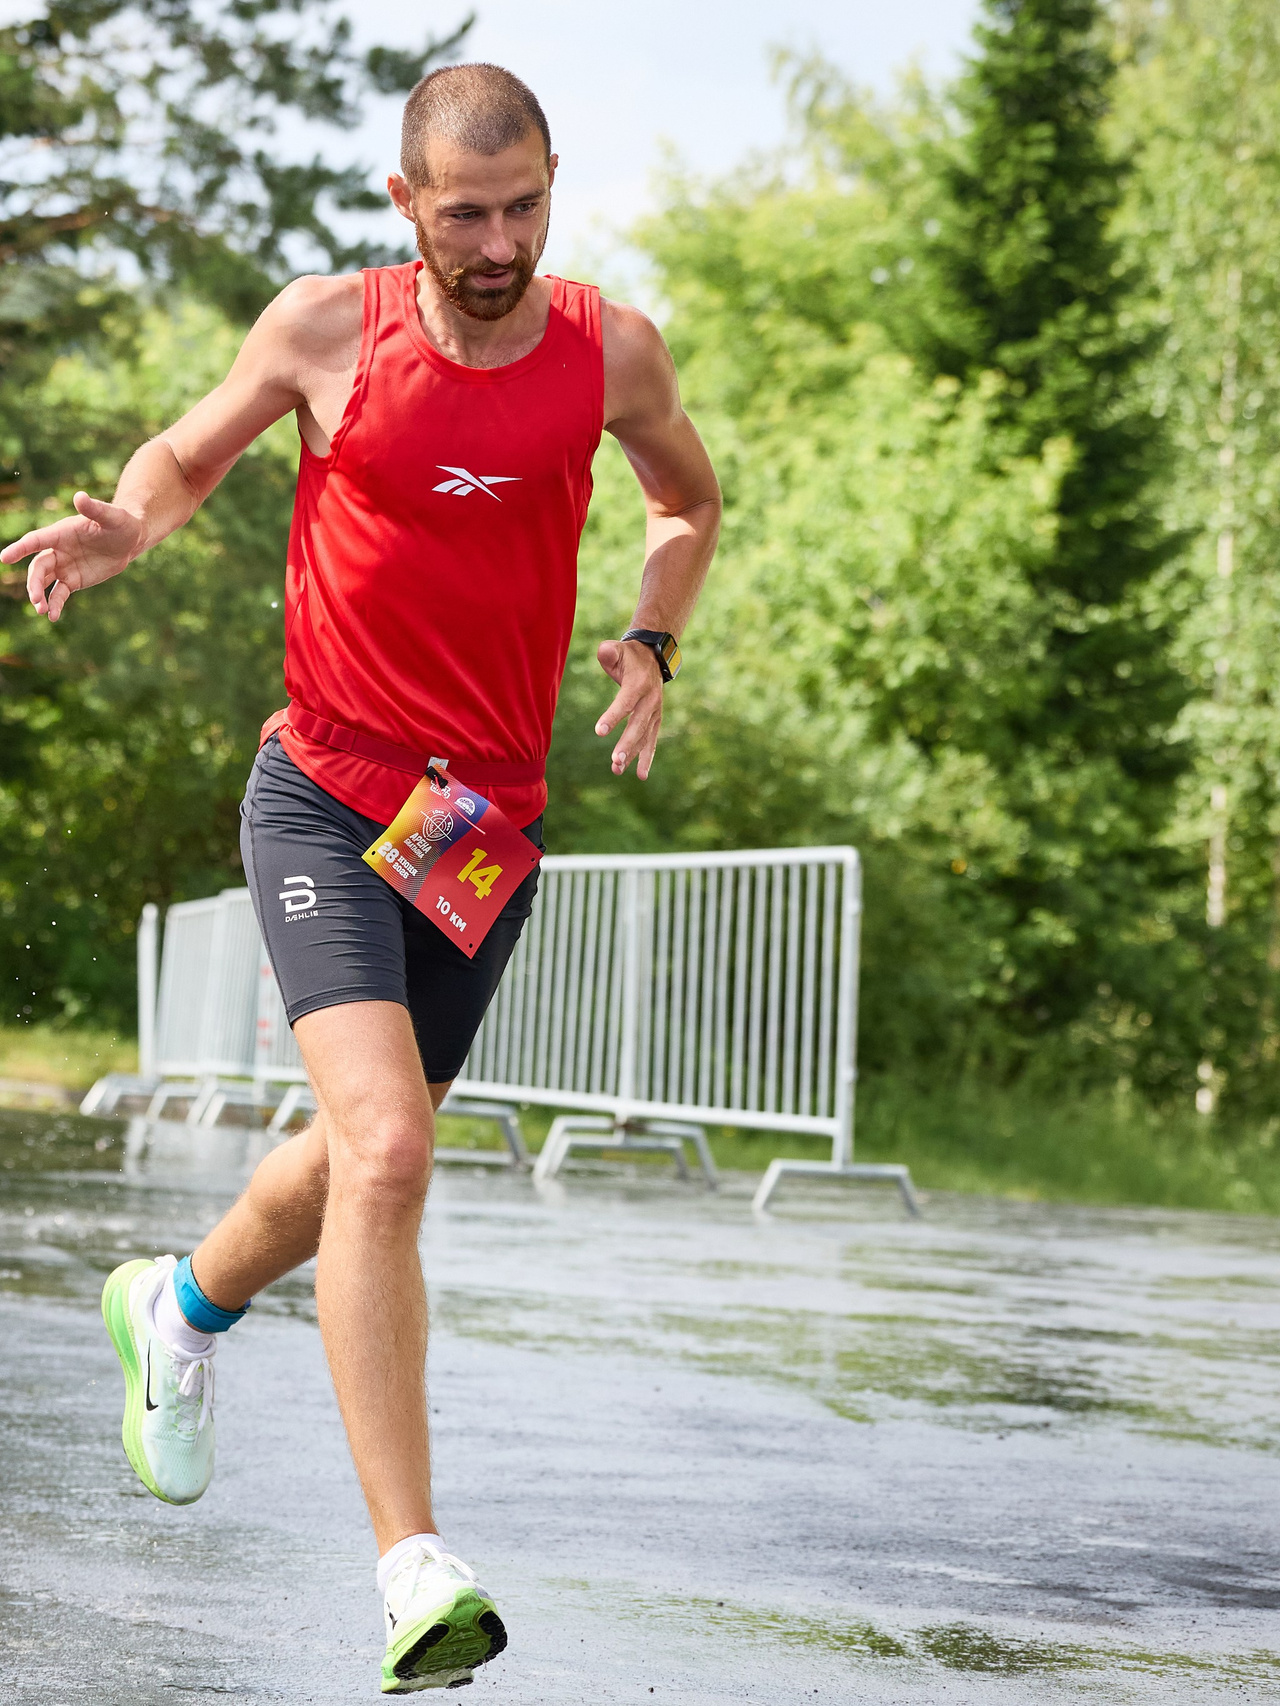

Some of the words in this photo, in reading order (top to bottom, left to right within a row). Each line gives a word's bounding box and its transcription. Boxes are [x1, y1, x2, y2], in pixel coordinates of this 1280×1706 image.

[377, 842, 398, 863] 28
[456, 848, 503, 900] 14
[435, 896, 451, 915] 10
